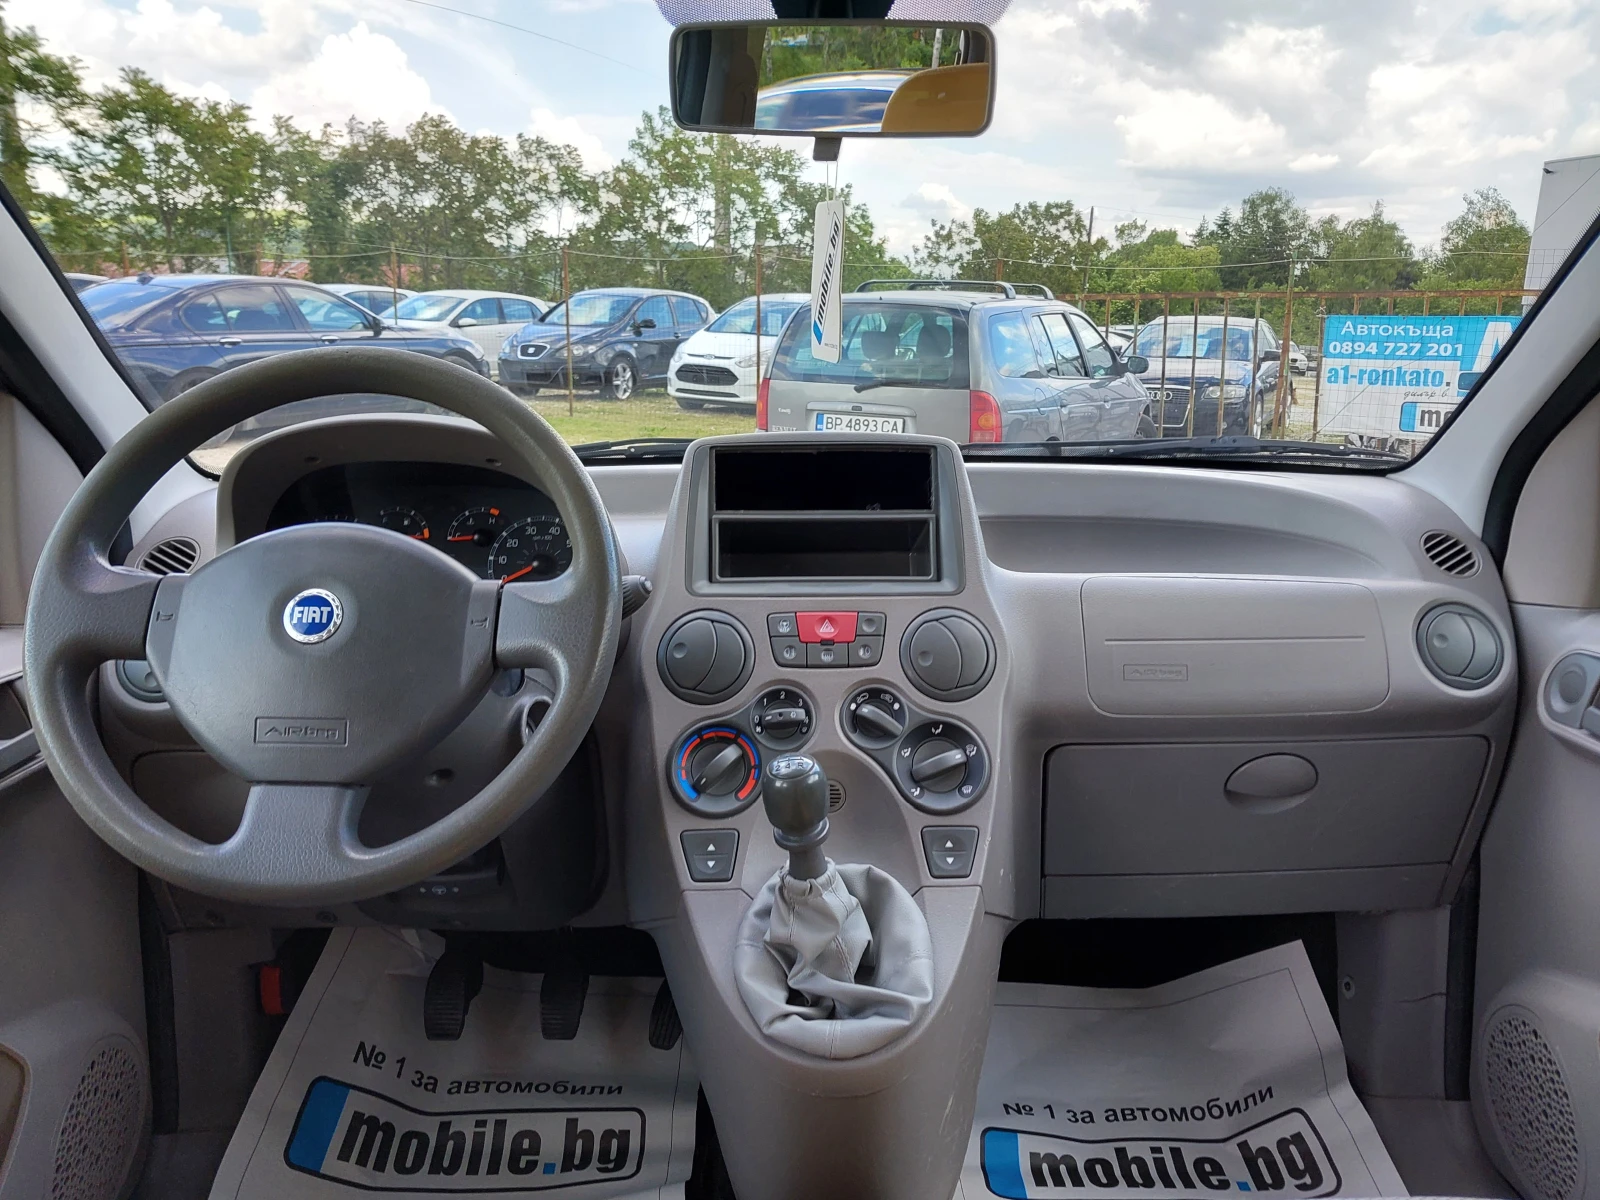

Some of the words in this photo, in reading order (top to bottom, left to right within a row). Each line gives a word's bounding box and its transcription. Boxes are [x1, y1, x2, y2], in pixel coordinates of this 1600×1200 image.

[1340, 321, 1454, 338] Автокъща
[1329, 341, 1378, 355] 0894
[1383, 342, 1422, 356] 727
[1426, 343, 1463, 357] 201
[846, 418, 878, 432] 4893
[525, 526, 537, 535] 30
[548, 526, 560, 536] 40
[506, 539, 519, 548] 20
[498, 555, 508, 564] 10
[292, 606, 332, 624] FIAT
[780, 690, 786, 700] 2
[352, 1041, 386, 1070] №
[395, 1057, 407, 1079] 1
[411, 1069, 439, 1094] за
[447, 1078, 624, 1096] автомобили
[1002, 1102, 1035, 1117] №
[1044, 1105, 1056, 1120] 1
[1066, 1108, 1095, 1125] за
[1104, 1085, 1275, 1123] автомобили
[336, 1110, 632, 1177] mobile.bg
[1028, 1130, 1325, 1193] mobile.bg
